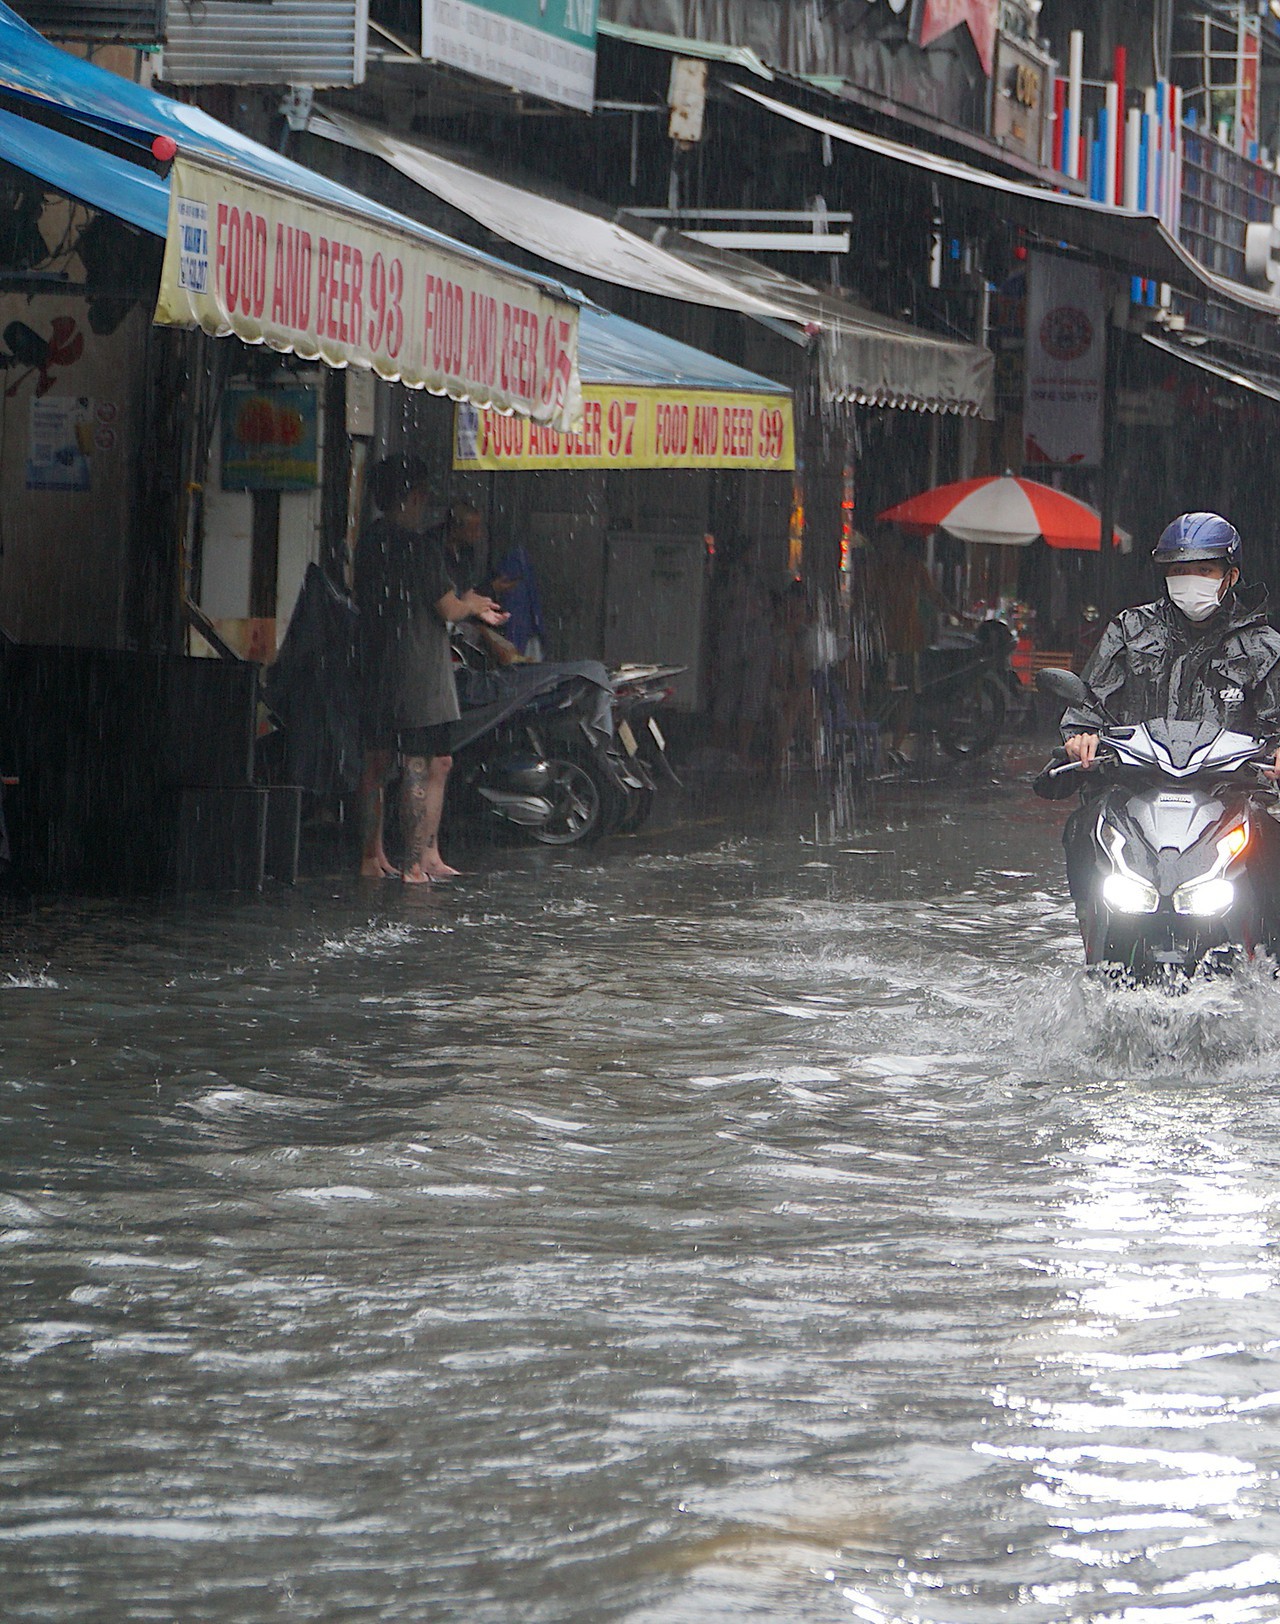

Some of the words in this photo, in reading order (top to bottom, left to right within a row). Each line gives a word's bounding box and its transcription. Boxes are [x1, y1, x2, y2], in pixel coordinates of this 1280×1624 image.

[216, 203, 267, 318] FOOD
[271, 223, 312, 331] AND
[316, 237, 364, 346] BEER
[368, 252, 404, 359] 93
[424, 274, 464, 377] FOOD
[466, 291, 498, 388] AND
[501, 303, 539, 400] BEER
[608, 401, 637, 457] 97
[656, 404, 689, 456] FOOD
[692, 406, 719, 456] AND
[722, 407, 754, 457] BEER
[758, 407, 784, 459] 99
